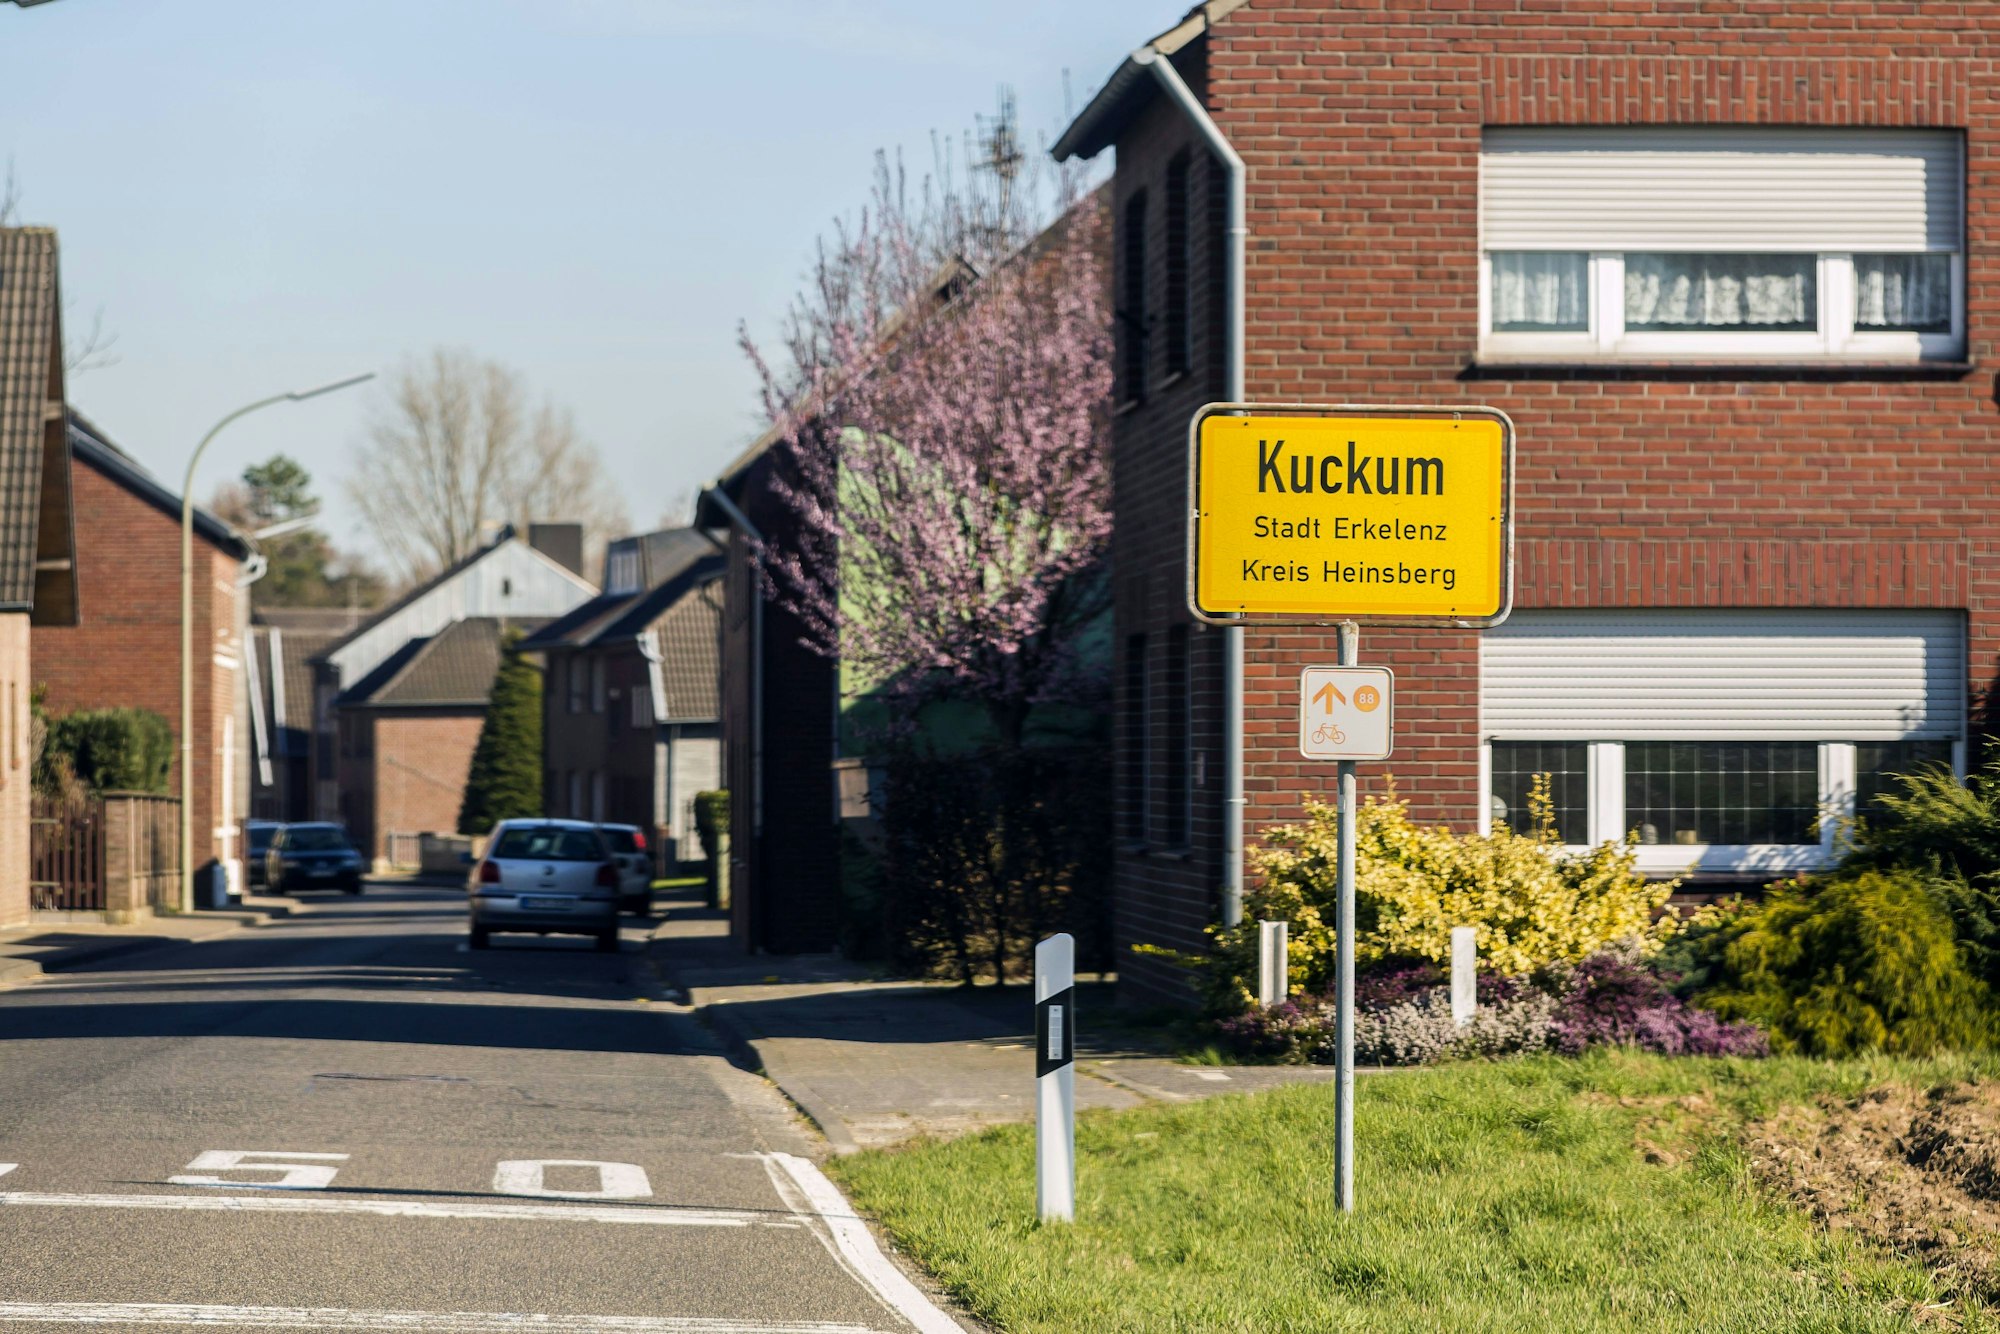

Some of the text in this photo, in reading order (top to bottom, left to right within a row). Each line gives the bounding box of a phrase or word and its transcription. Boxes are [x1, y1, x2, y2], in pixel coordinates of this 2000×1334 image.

[1258, 439, 1444, 496] Kuckum
[1254, 516, 1447, 541] Stadt Erkelenz
[1242, 559, 1456, 590] Kreis Heinsberg
[1359, 693, 1375, 704] 88
[167, 1149, 653, 1199] 50
